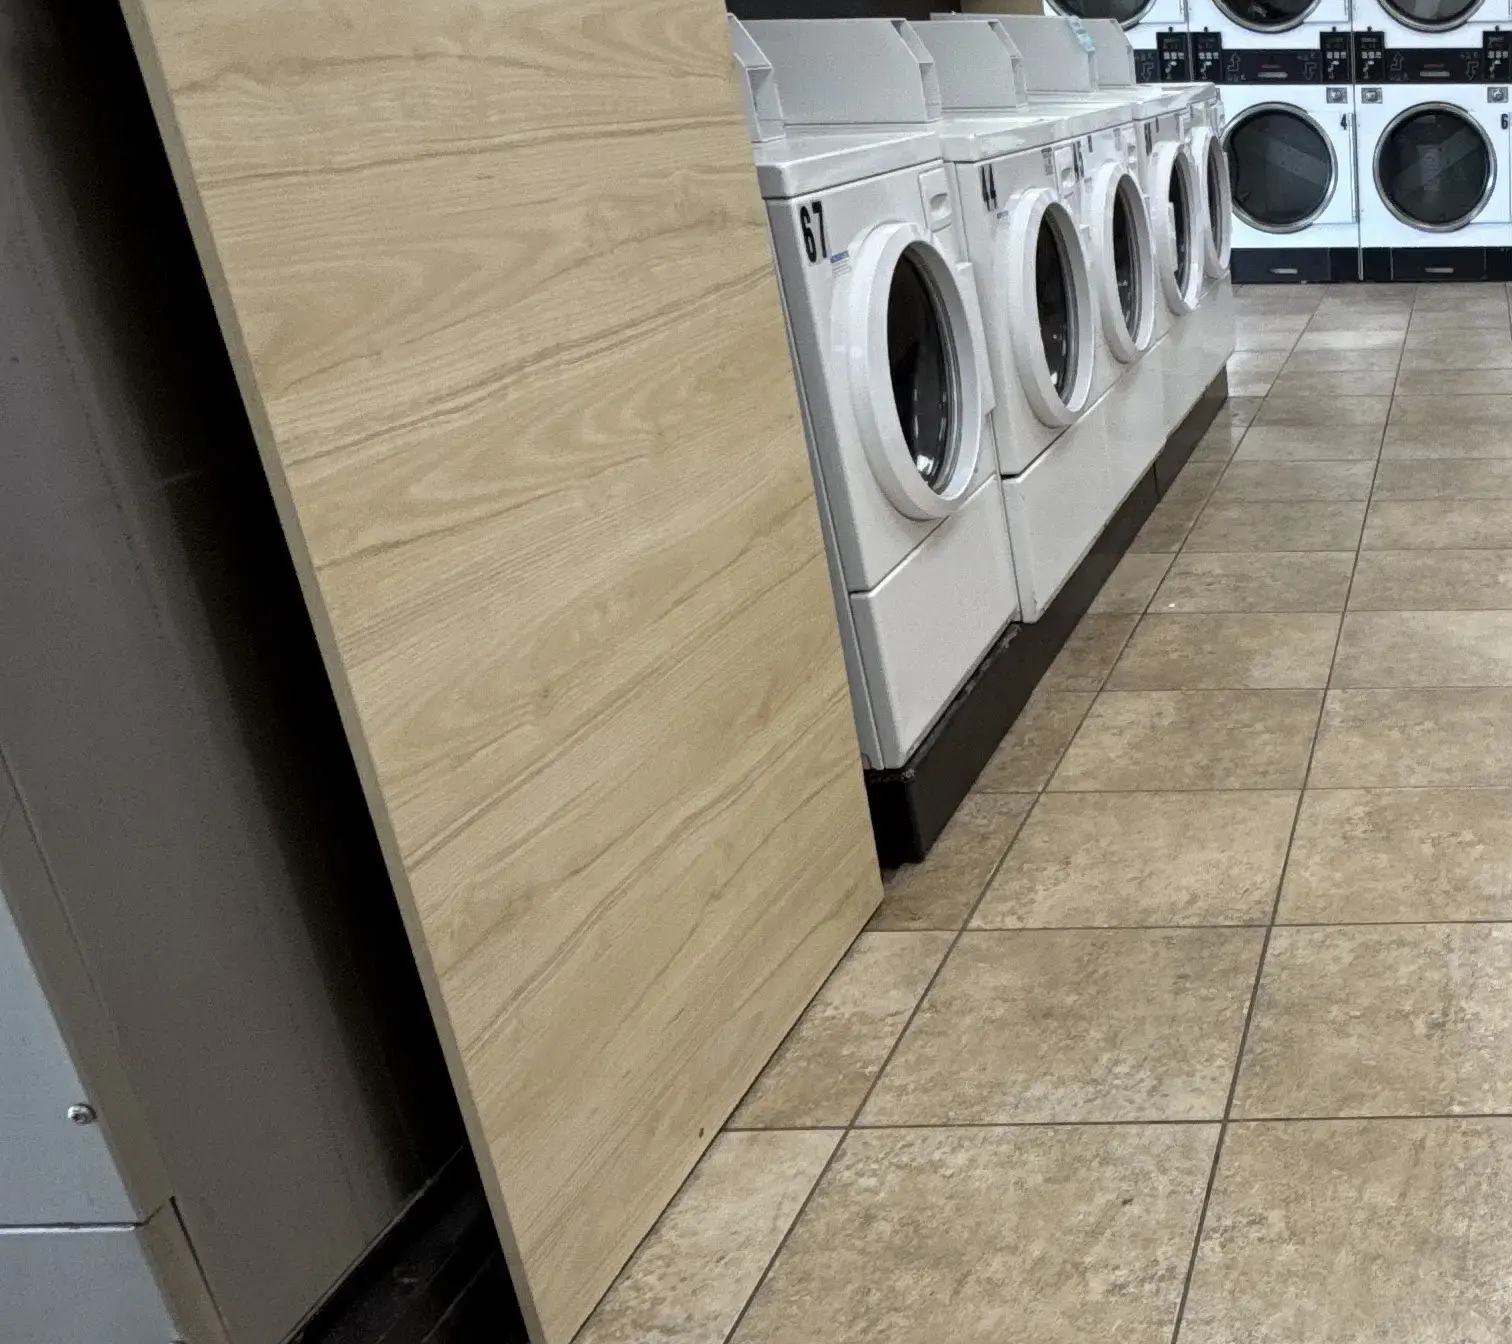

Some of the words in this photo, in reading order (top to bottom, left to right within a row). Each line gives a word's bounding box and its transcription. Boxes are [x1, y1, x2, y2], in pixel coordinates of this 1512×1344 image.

[1340, 113, 1347, 131] 4
[1501, 113, 1508, 130] 6
[800, 201, 827, 263] 67
